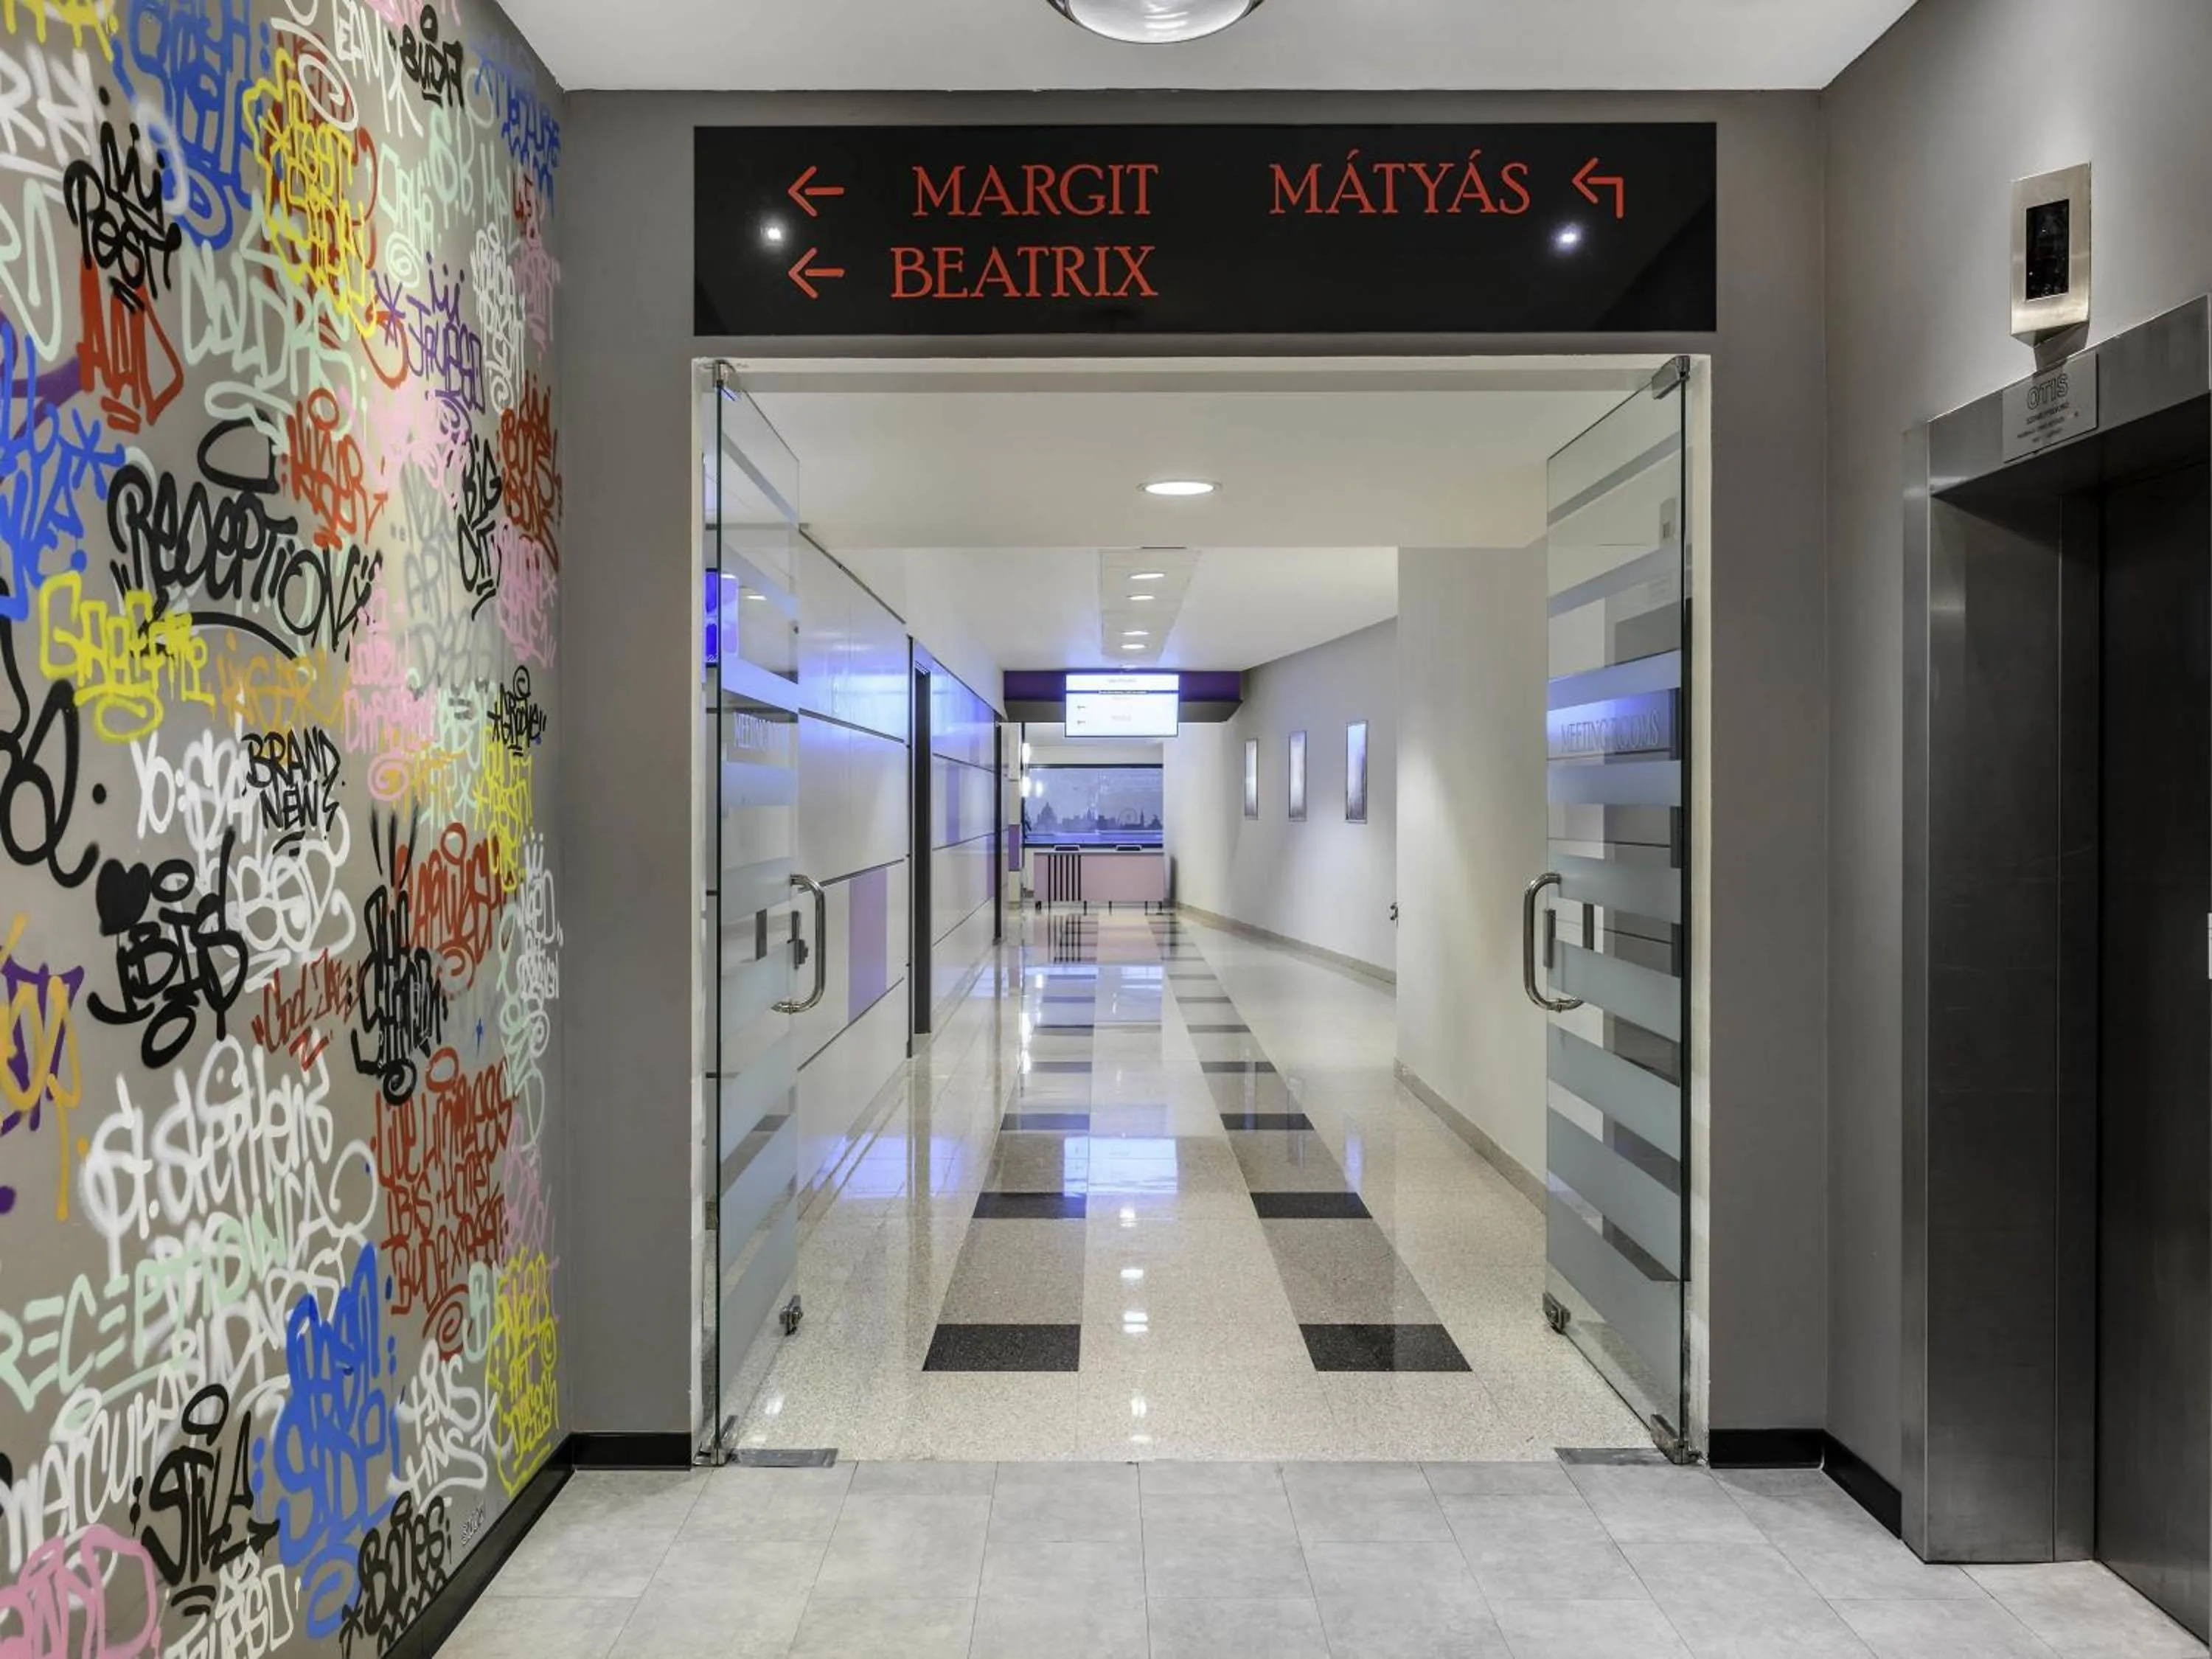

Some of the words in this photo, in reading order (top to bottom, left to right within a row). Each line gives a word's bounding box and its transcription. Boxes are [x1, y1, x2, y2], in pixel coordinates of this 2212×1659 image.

[911, 164, 1159, 216] MARGIT
[1268, 149, 1531, 215] MÁTYÁS
[891, 245, 1159, 298] BEATRIX
[2027, 373, 2068, 410] OTIS
